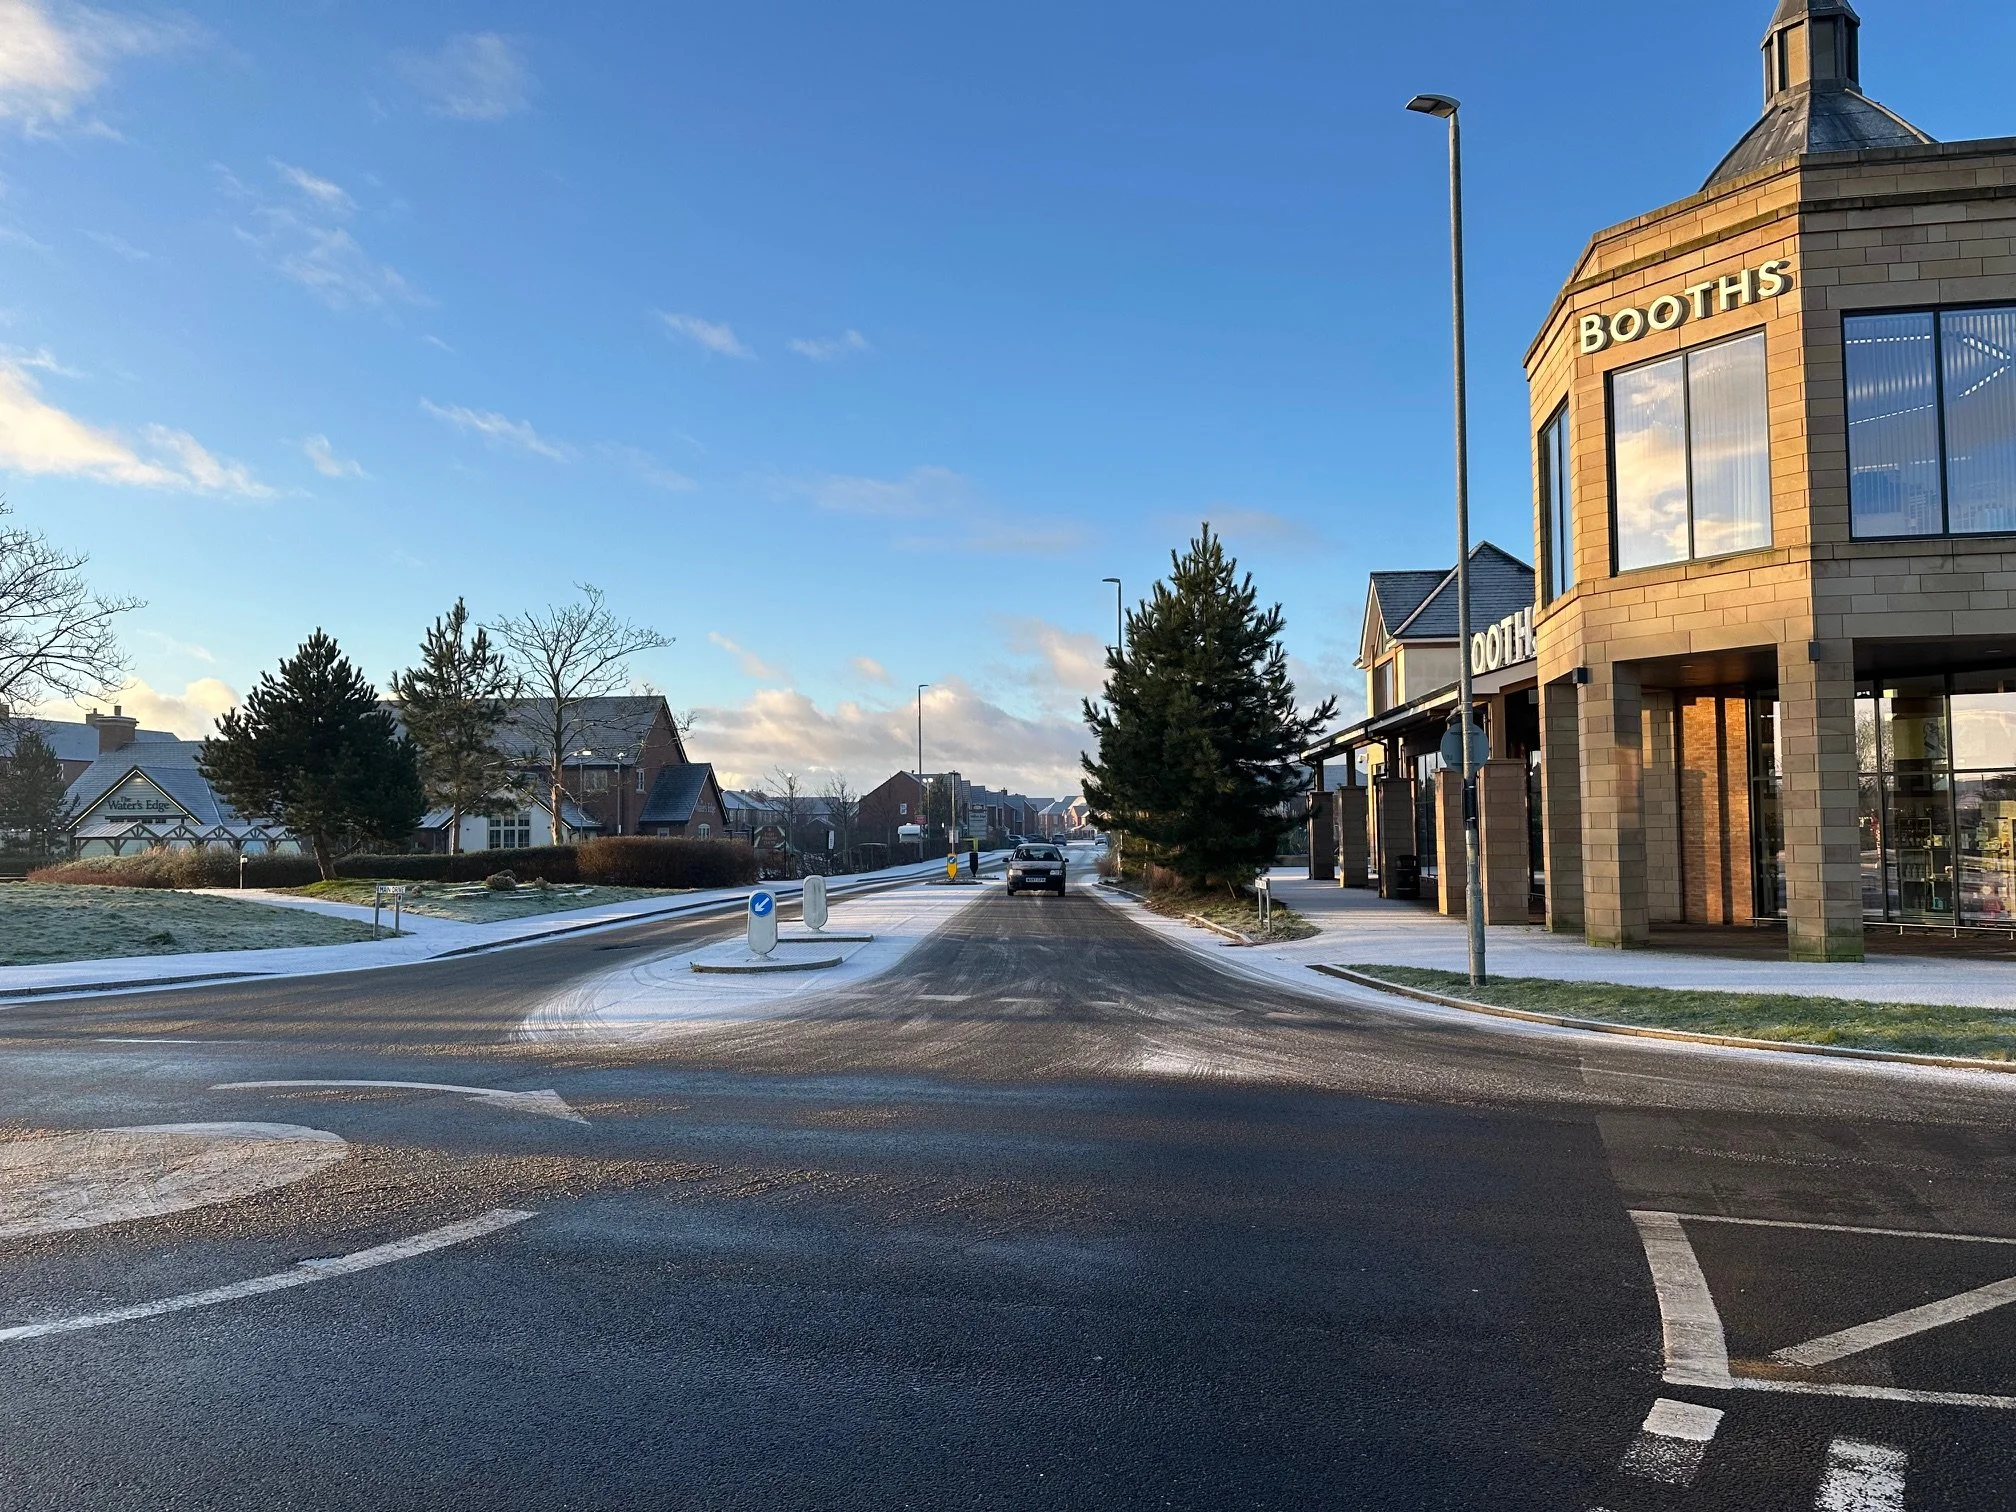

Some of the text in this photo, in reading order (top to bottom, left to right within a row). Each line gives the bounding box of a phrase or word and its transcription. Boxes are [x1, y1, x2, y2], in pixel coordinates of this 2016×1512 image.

[1579, 260, 1786, 354] BOOTHS
[1471, 602, 1537, 674] OOTH
[108, 799, 170, 812] Water's Edge
